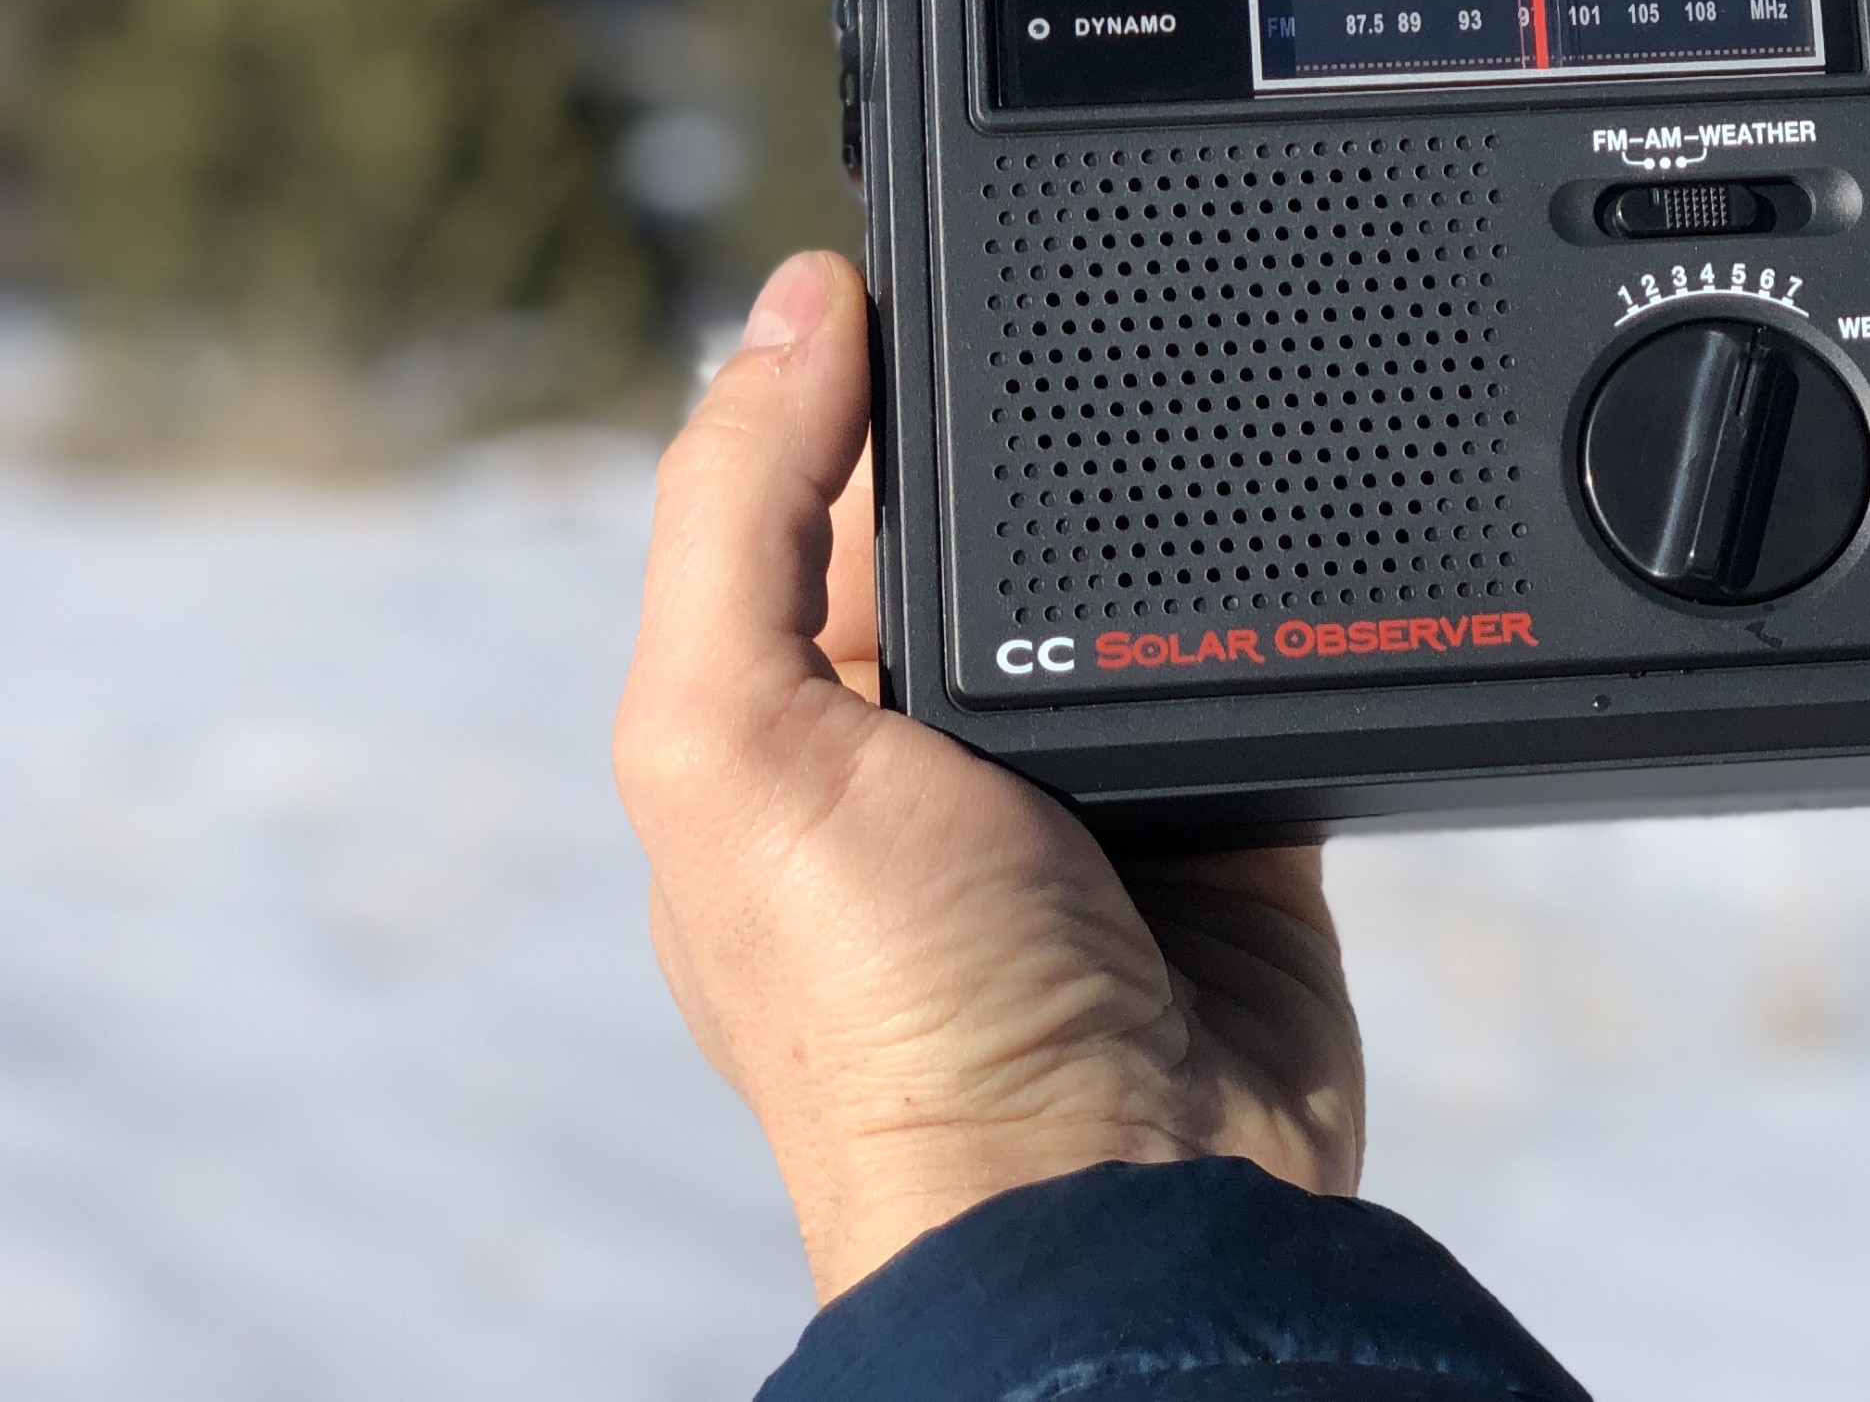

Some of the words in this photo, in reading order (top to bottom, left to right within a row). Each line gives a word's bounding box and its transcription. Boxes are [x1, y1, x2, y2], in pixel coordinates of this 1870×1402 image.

[1075, 15, 1176, 36] DYNAMO
[1267, 15, 1296, 38] FM
[1346, 14, 1384, 34] 87.5
[1398, 12, 1421, 32] 89
[1459, 10, 1482, 30] 93
[1569, 6, 1600, 25] 101
[1628, 3, 1659, 23] 105
[1685, 1, 1716, 21] 108
[1617, 285, 1633, 305] 1
[1641, 274, 1657, 295] 2
[1672, 266, 1687, 286] 3
[1700, 263, 1715, 284] 4
[1731, 263, 1746, 284] 5
[1760, 269, 1775, 289] 6
[1787, 276, 1803, 296] 7
[996, 637, 1074, 674] CC
